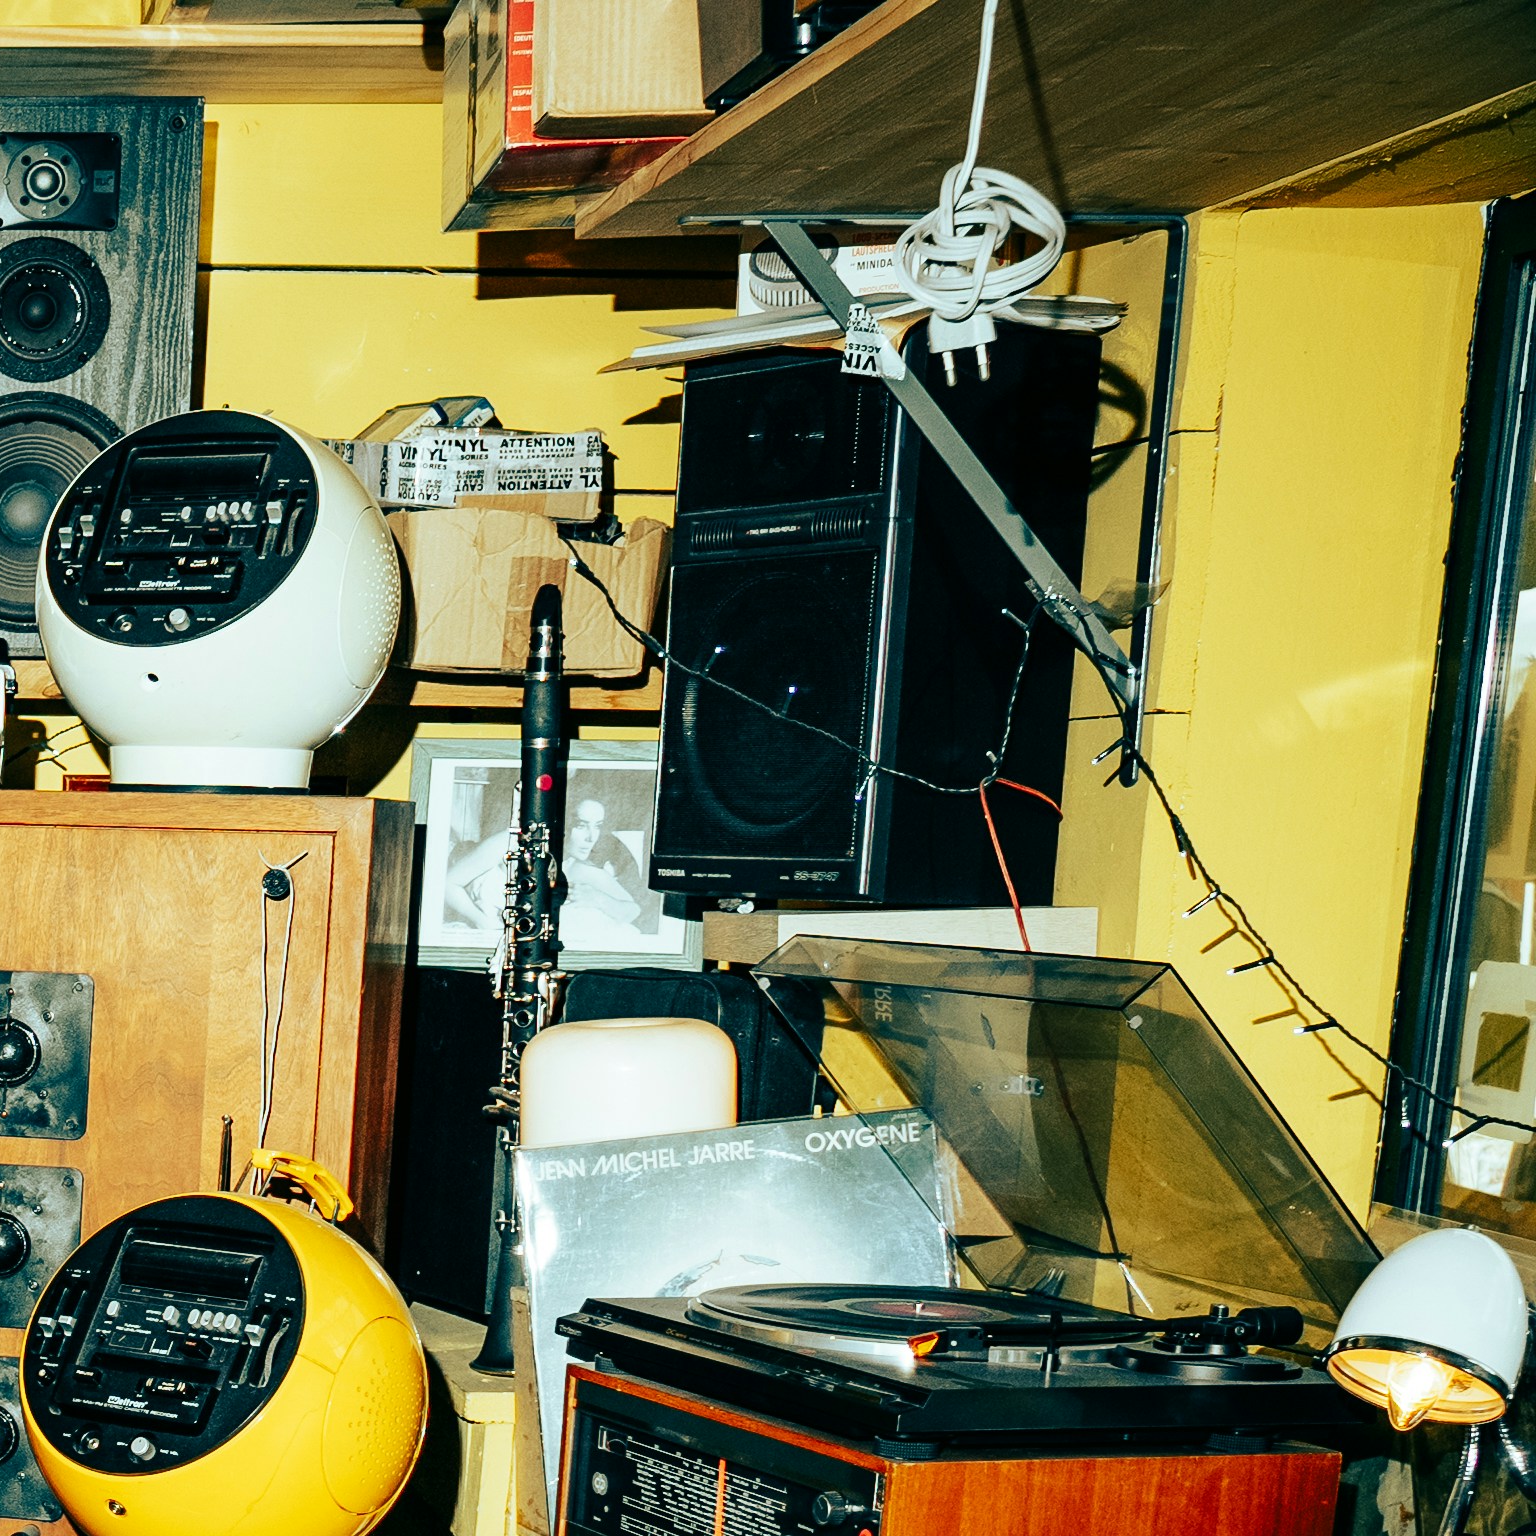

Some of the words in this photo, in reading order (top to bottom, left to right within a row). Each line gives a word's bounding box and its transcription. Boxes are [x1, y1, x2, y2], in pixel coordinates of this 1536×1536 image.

[858, 283, 900, 293] PRODUCTION
[499, 436, 575, 448] ATTENTION
[497, 479, 572, 491] ATTENTION
[804, 1122, 921, 1153] OXYGENE
[536, 1157, 586, 1182] JEAN
[591, 1149, 681, 1177] MICHEL
[687, 1140, 756, 1166] JARRE
[107, 1395, 148, 1408] Weltron
